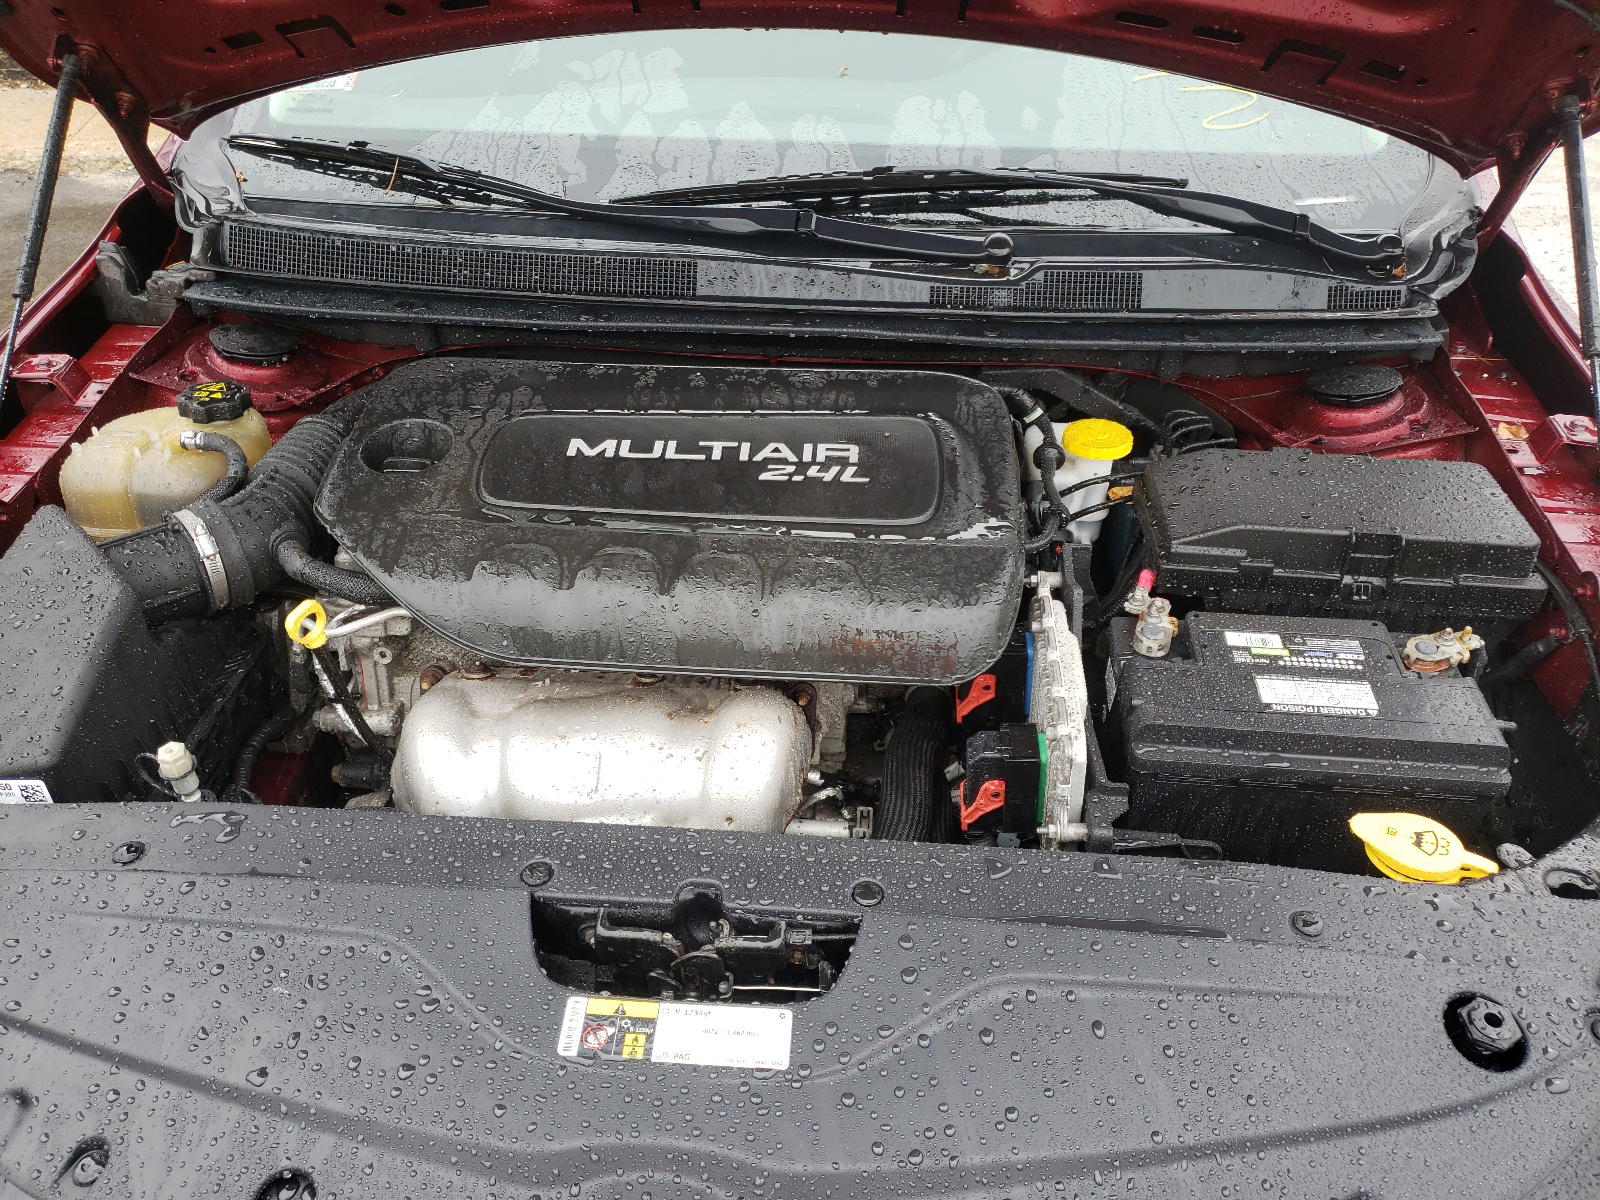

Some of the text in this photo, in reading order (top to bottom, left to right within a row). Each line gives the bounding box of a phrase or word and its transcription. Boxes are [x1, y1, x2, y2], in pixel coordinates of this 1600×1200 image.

[566, 438, 860, 463] MULTIAIR
[758, 464, 870, 483] 2.4L
[1272, 703, 1313, 713] POISON
[1319, 705, 1366, 716] DANGER
